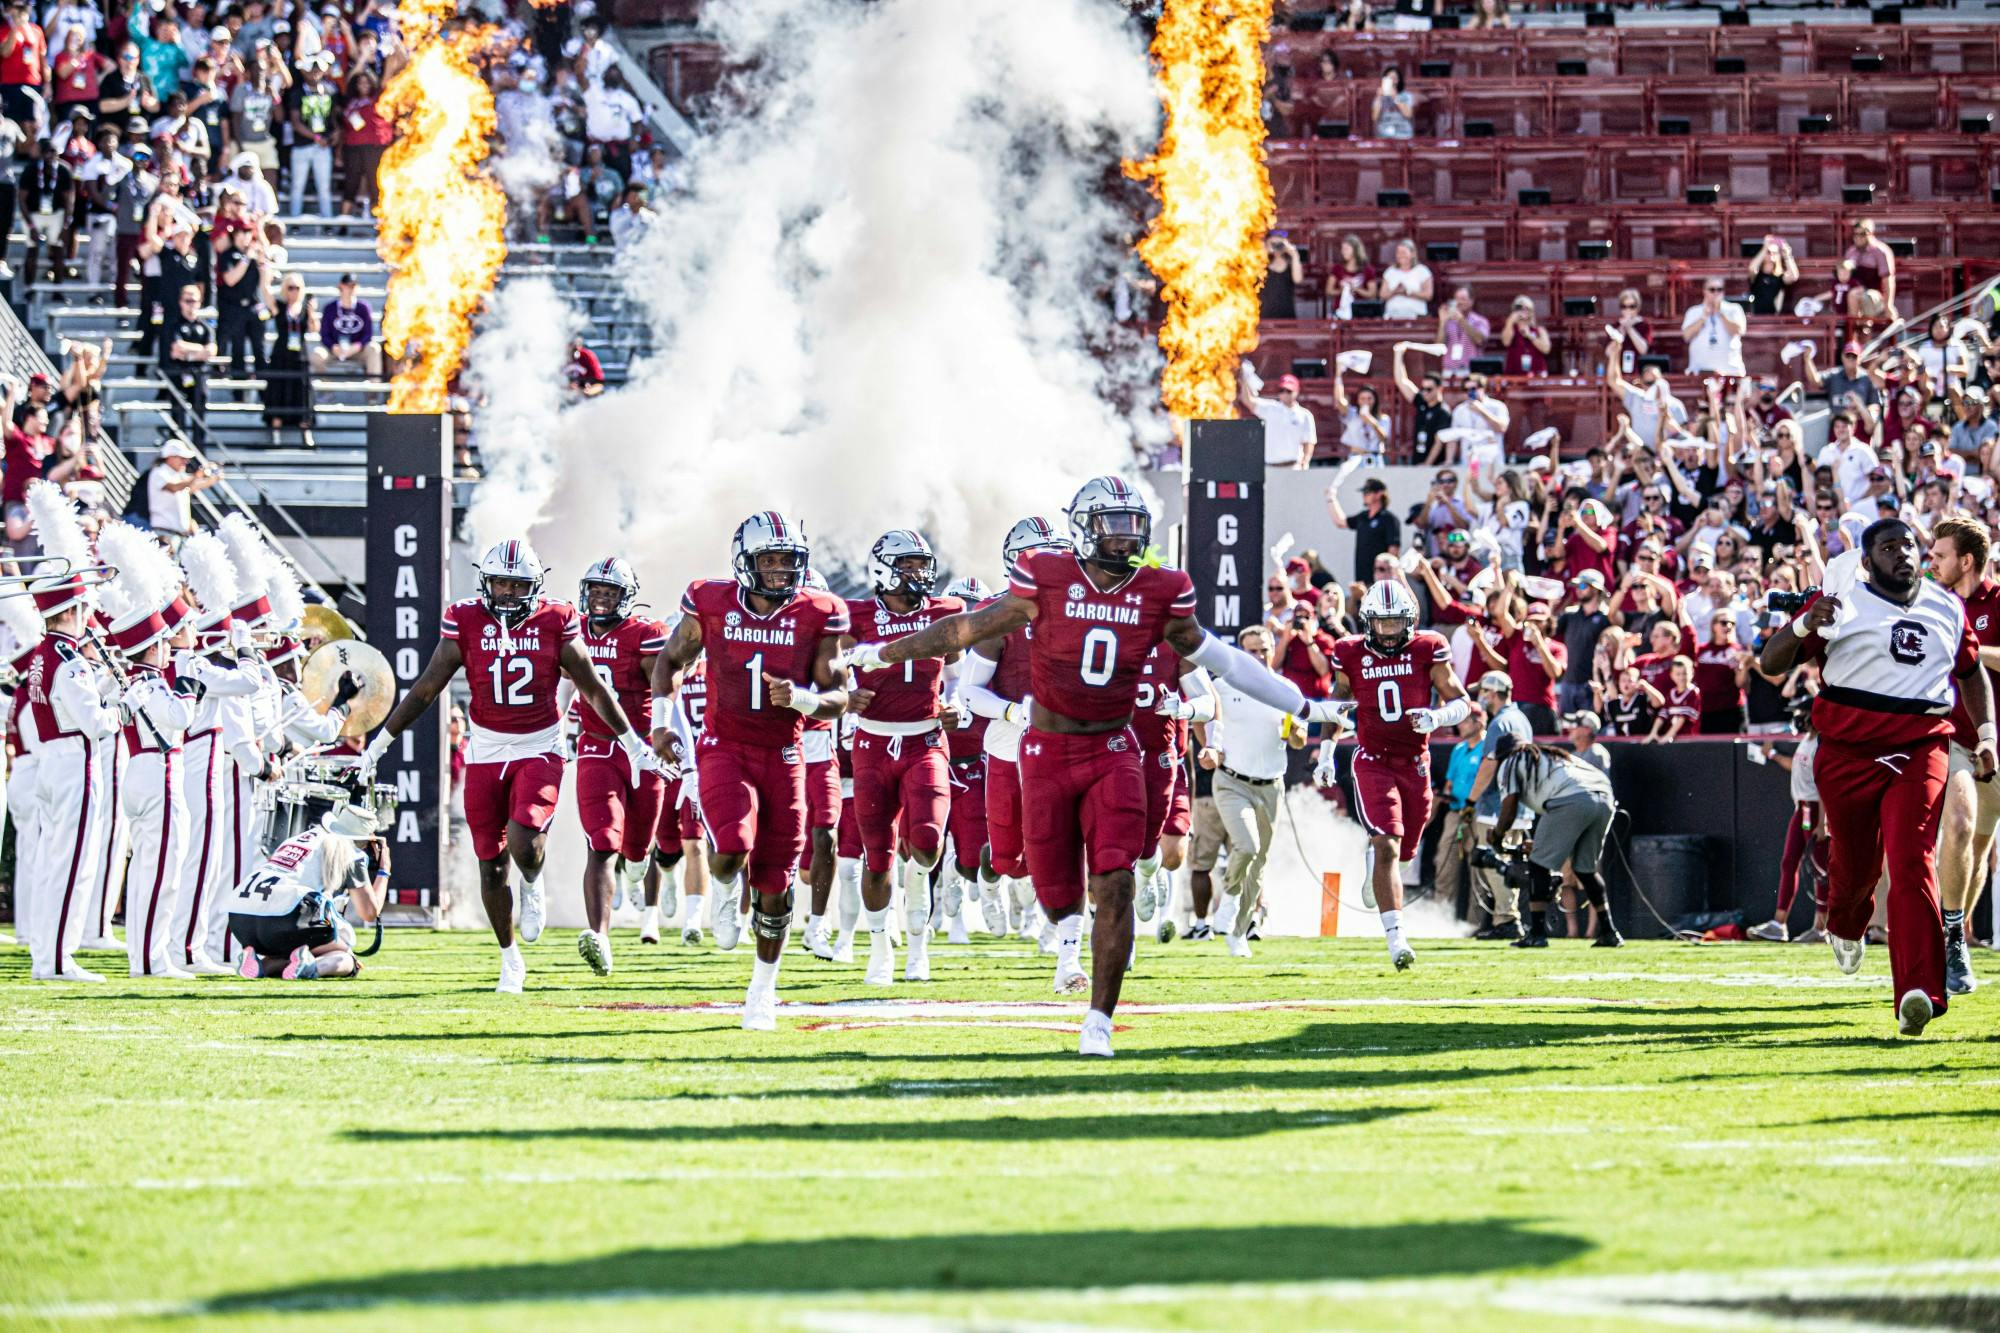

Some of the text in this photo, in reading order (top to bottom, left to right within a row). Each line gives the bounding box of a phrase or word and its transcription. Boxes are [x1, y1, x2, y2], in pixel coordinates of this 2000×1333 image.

[1215, 514, 1240, 644] GAM
[1065, 602, 1139, 624] CAROLINA
[481, 638, 540, 651] CARLINA
[724, 626, 794, 646] CAROLINA
[1081, 628, 1117, 685] 0
[394, 525, 421, 842] CAROINA
[488, 657, 533, 704] 12
[745, 653, 763, 709] 1
[1361, 663, 1413, 680] CAROLINA
[1377, 681, 1402, 722] 0
[239, 872, 281, 901] 14
